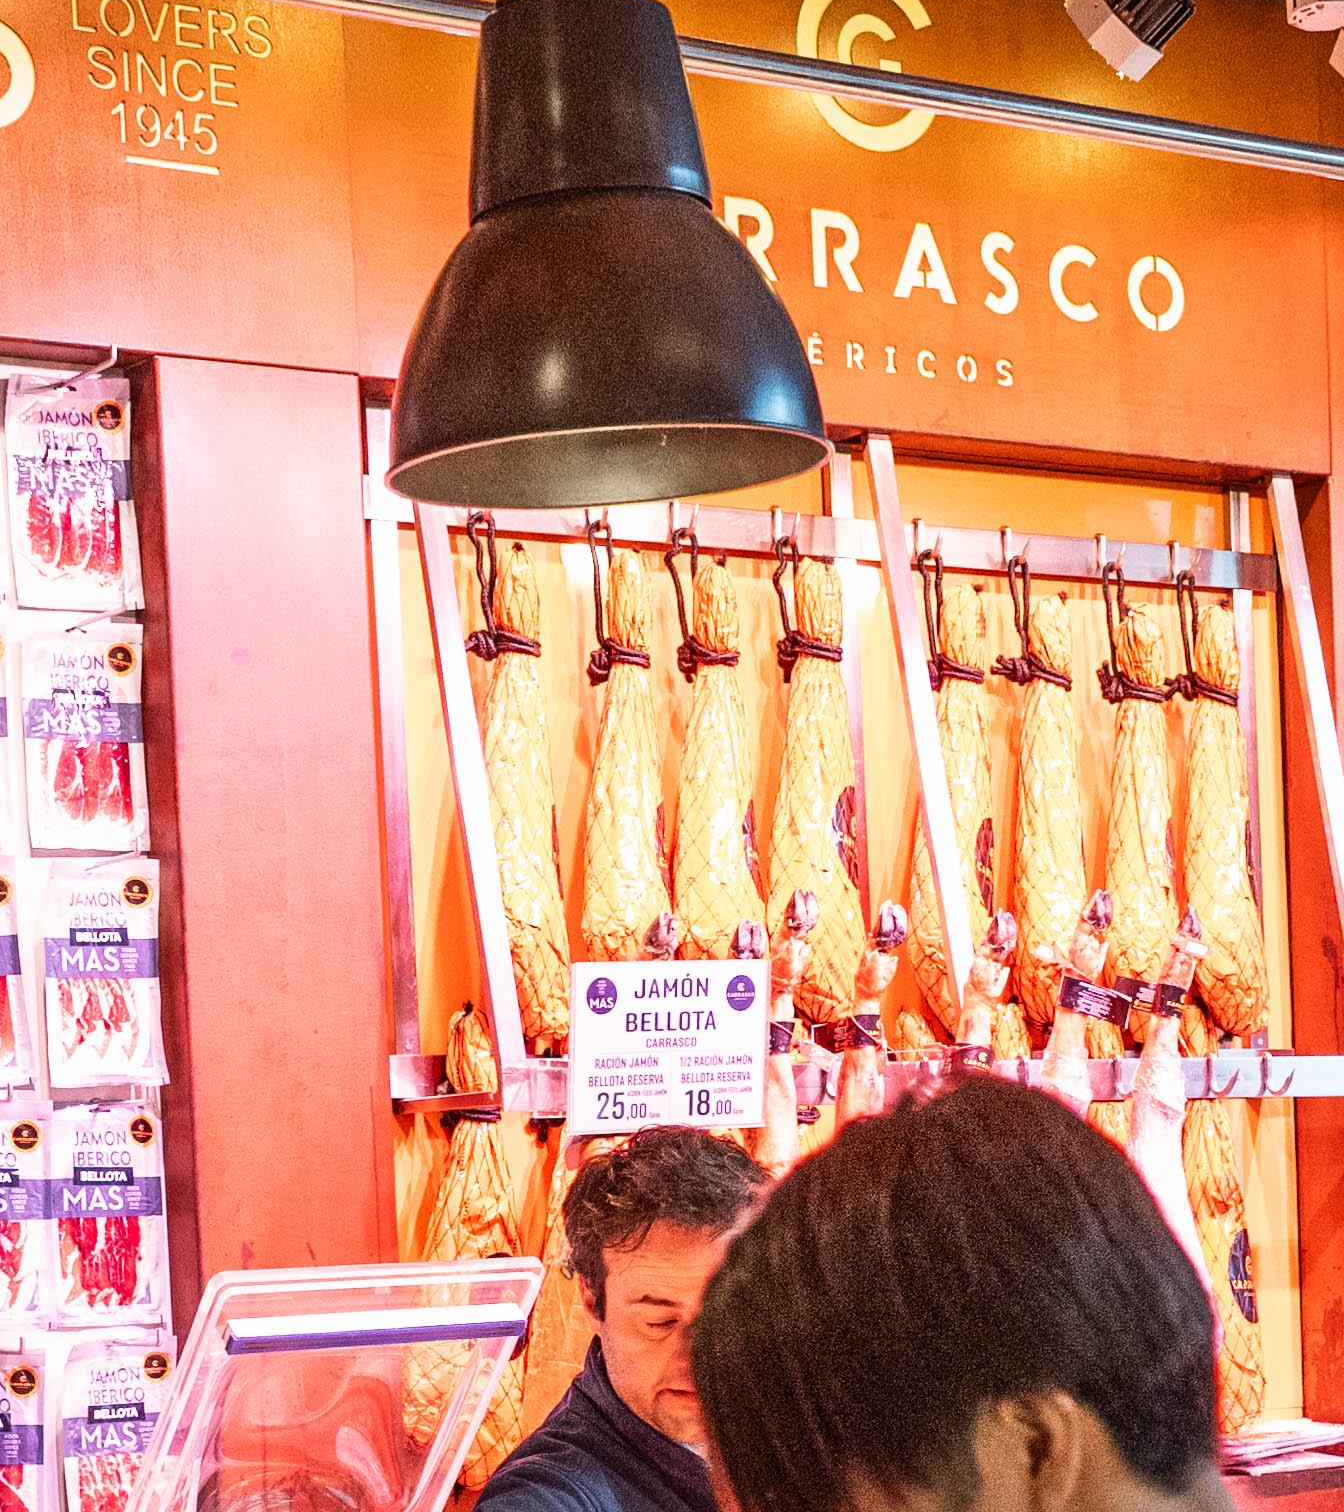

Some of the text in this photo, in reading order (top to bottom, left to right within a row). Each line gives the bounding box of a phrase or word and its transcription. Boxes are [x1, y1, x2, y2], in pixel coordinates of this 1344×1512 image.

[87, 46, 239, 107] SINCE
[111, 100, 218, 155] 1945
[721, 195, 1186, 332] RRASCO
[807, 331, 1015, 388] ÉRICOS
[60, 946, 121, 973] MAS
[634, 973, 710, 999] JAMÓN
[589, 996, 615, 1010] MAS
[625, 1010, 717, 1033] BELLOTA
[645, 1037, 697, 1049] CARRASCO
[594, 1054, 659, 1070] RACIÓN JAMÓN
[694, 1054, 723, 1068] RACIÓN
[726, 1053, 753, 1066] JAMÓN
[588, 1073, 664, 1088] BELLOTA RESERVA
[680, 1070, 752, 1084] BELLOTA RESERVA
[79, 1170, 128, 1182] BELLOTA
[62, 1185, 124, 1212] MAS
[93, 1407, 139, 1420] BELLOTA
[79, 1422, 138, 1450] MAS
